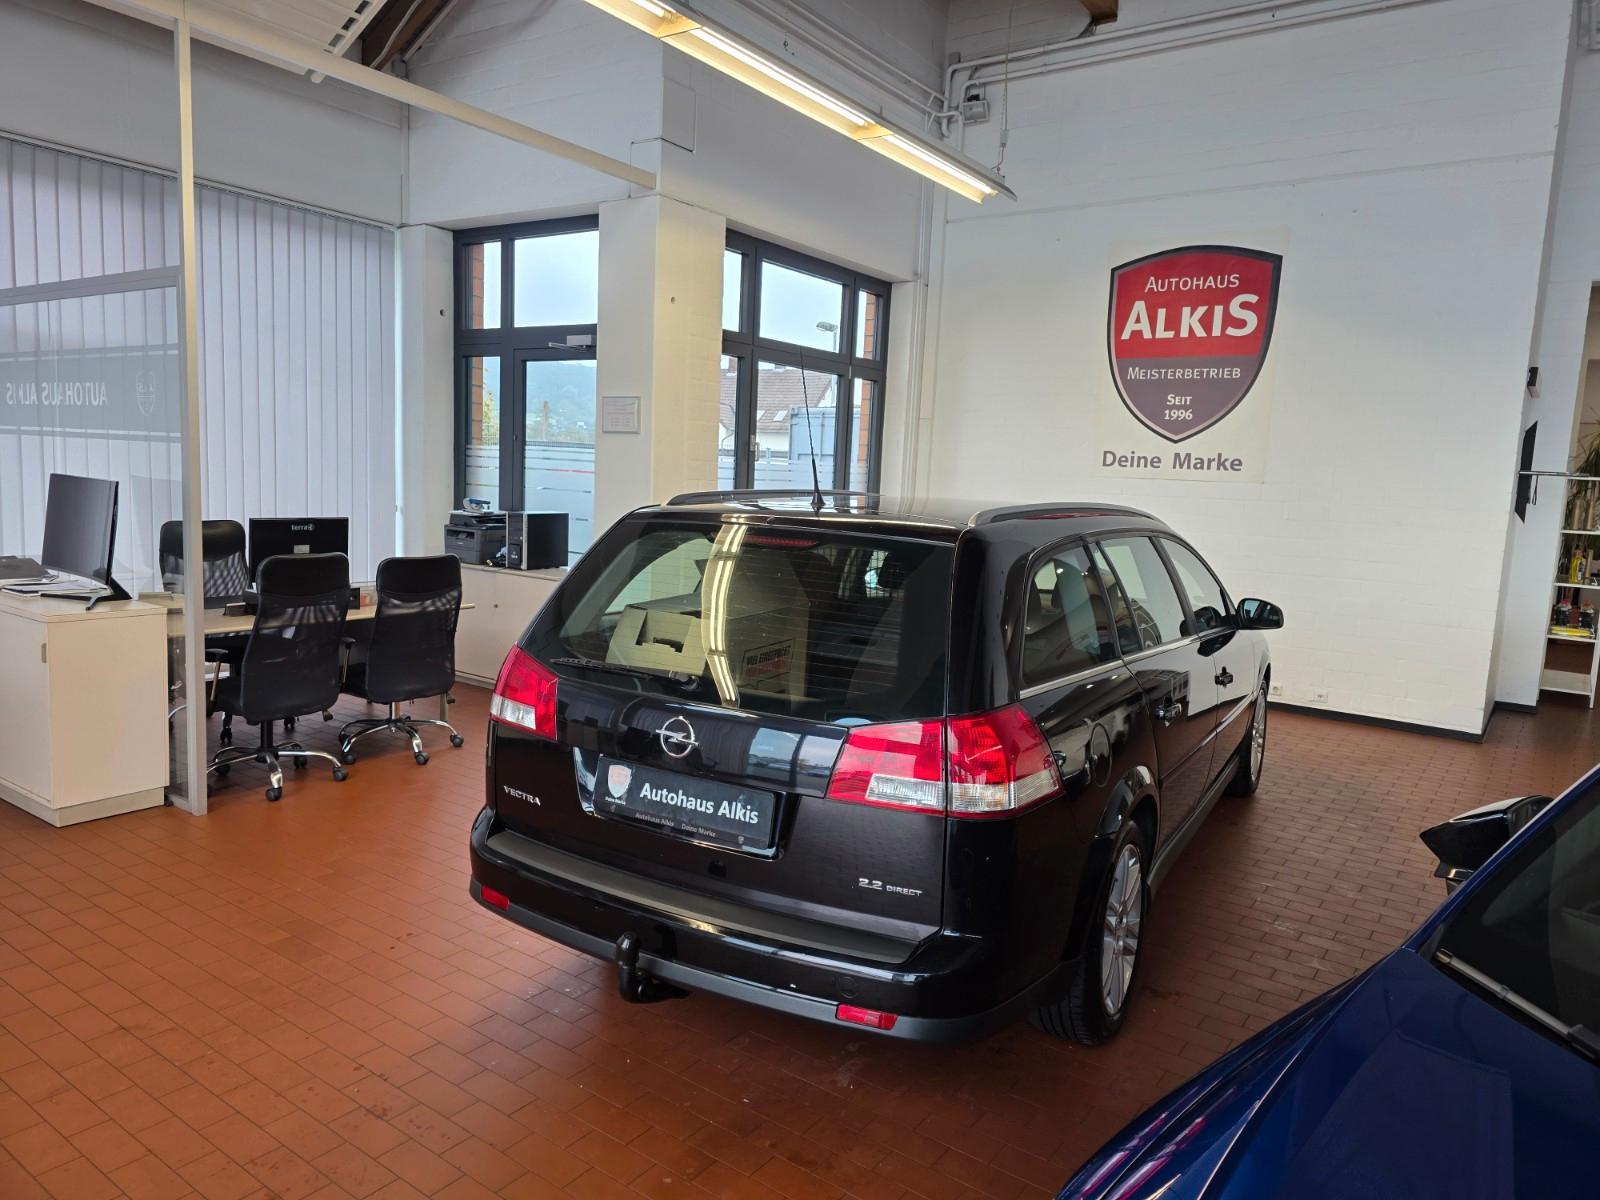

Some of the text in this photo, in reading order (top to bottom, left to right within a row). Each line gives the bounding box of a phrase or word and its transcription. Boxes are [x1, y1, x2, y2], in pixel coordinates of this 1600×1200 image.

[1145, 274, 1240, 293] AUTOHAUS
[1120, 293, 1259, 340] ALKIS
[1127, 366, 1241, 380] MEISTERBETRIEB
[1166, 394, 1193, 405] SEIT
[1164, 409, 1193, 421] 1996
[1102, 451, 1243, 472] Deine Marke
[503, 785, 541, 806] VECTRA
[640, 782, 759, 825] Autohaus Alkis
[859, 877, 923, 896] 2.2 DIRECT
